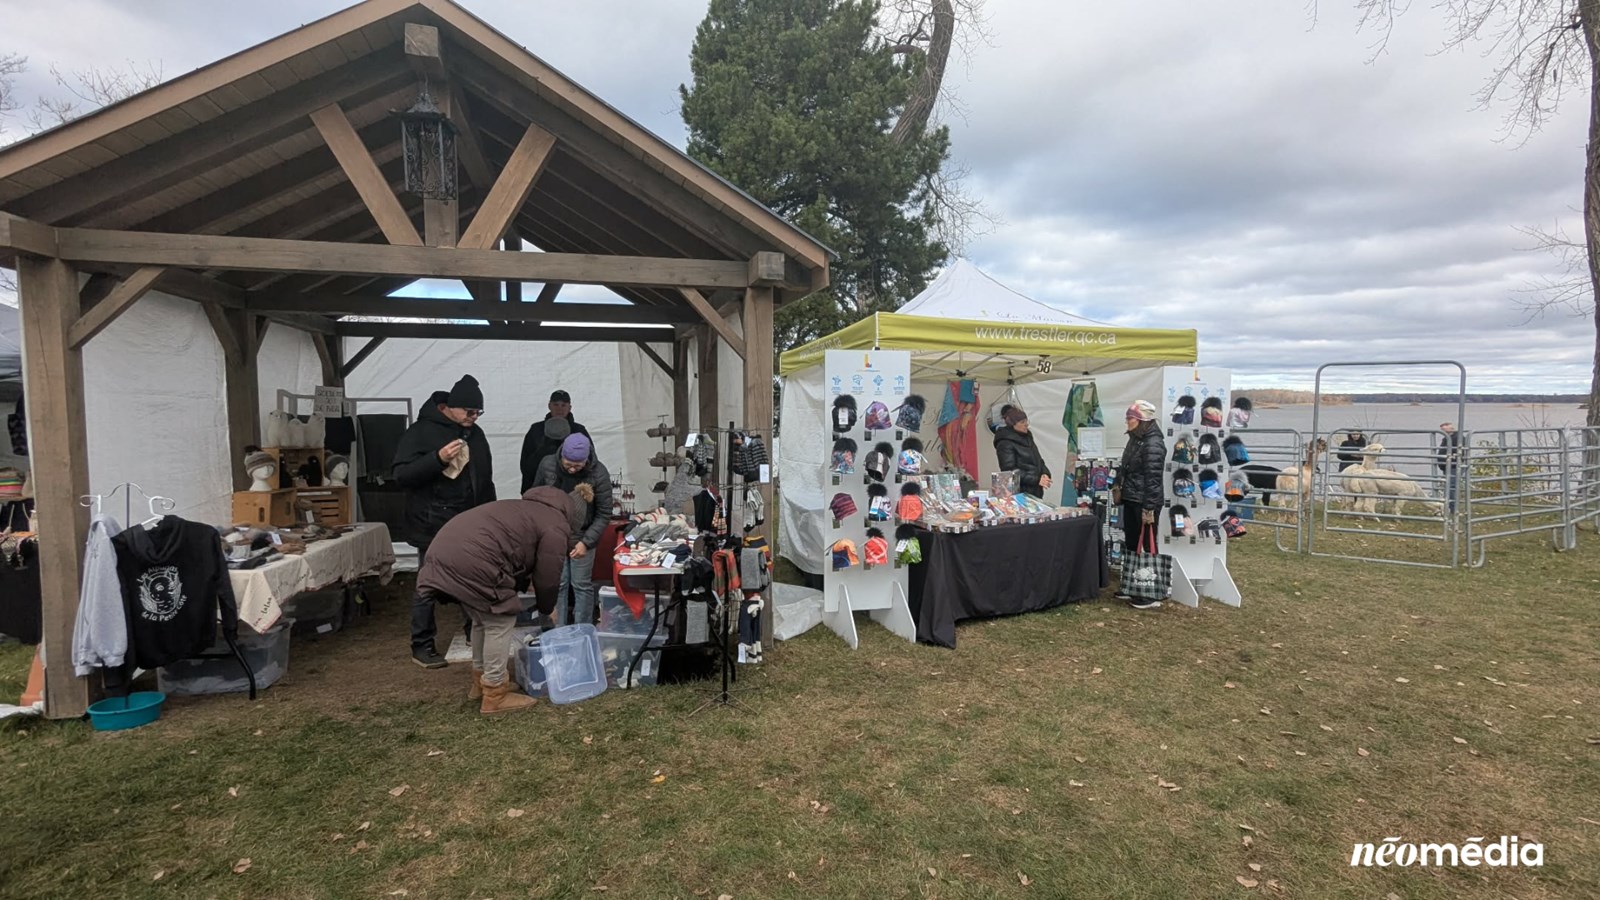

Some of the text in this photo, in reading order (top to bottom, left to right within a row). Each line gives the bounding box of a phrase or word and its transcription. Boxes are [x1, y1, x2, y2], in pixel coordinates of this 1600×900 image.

[975, 325, 1116, 346] www.trestler.qc.ca
[1036, 359, 1052, 374] 58
[149, 612, 158, 621] la
